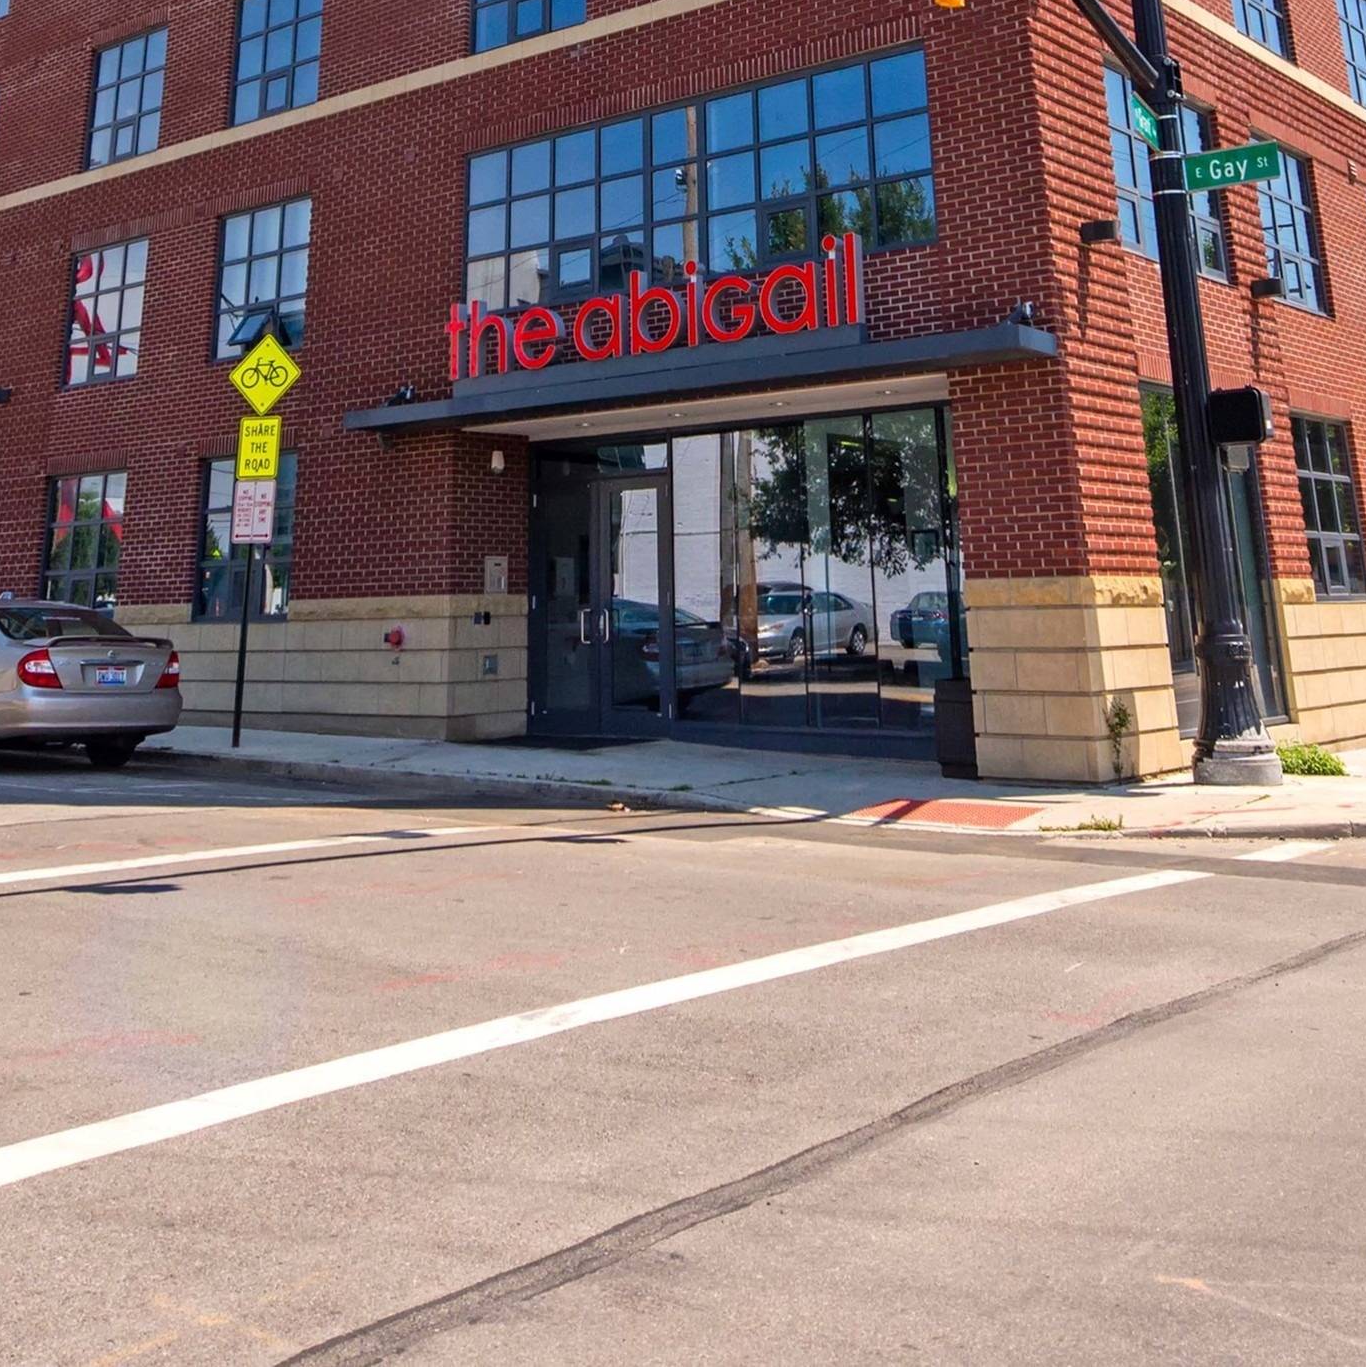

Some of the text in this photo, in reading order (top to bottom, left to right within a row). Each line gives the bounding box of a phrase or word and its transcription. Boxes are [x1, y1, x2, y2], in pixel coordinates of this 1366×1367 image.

[1195, 156, 1269, 180] E Gay St
[445, 299, 561, 381] the
[244, 423, 276, 438] SHARE
[250, 441, 268, 454] THE
[244, 458, 271, 471] ROAD
